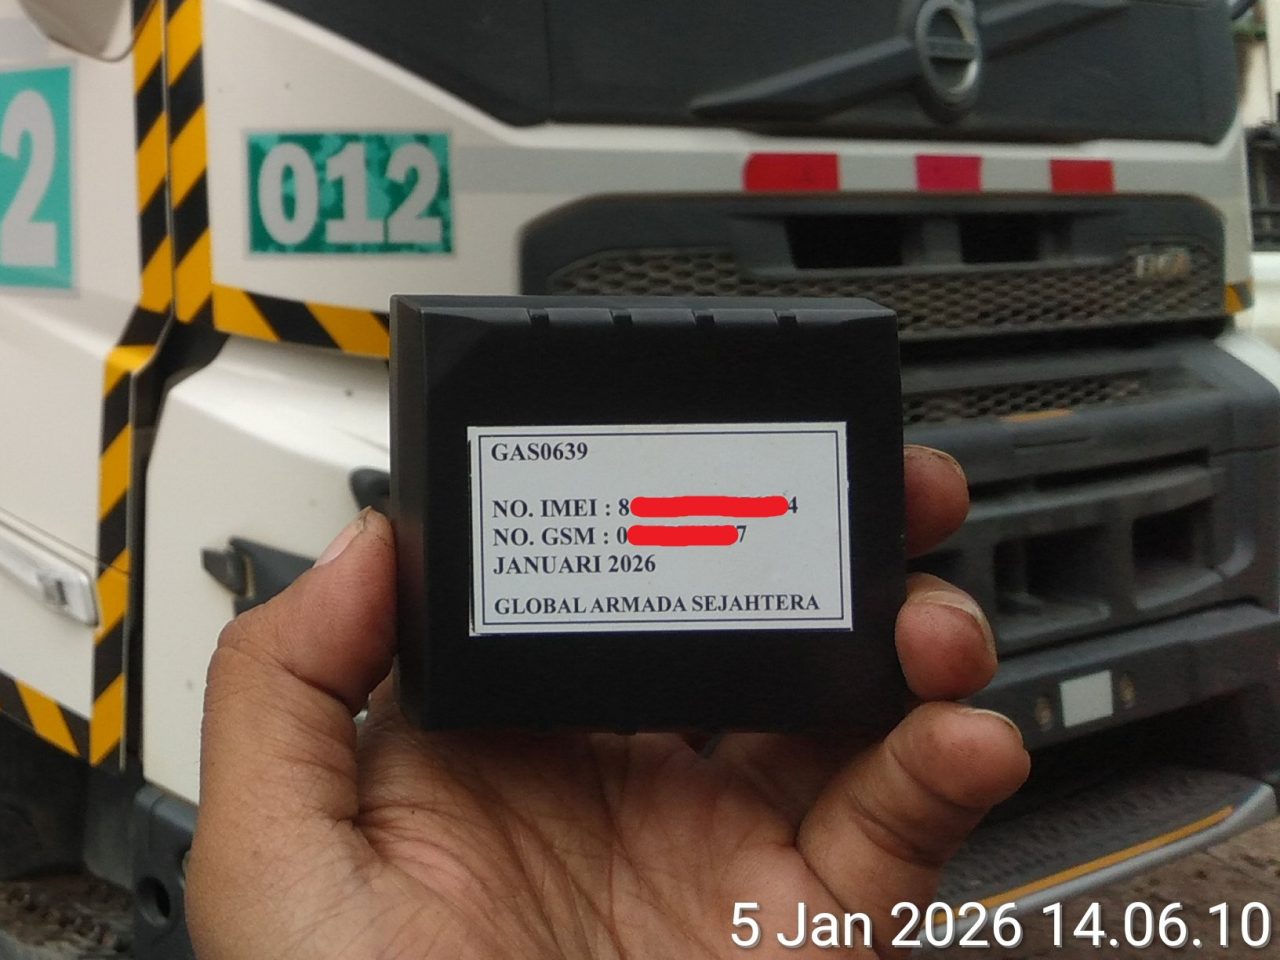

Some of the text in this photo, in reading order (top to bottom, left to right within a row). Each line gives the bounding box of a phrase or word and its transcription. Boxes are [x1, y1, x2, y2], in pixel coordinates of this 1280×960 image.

[257, 142, 442, 246] 012
[490, 441, 588, 462] GAS0639
[492, 499, 534, 518] NO.
[541, 498, 598, 517] IMEI
[492, 527, 534, 547] NO.
[541, 526, 596, 546] GSM
[493, 554, 656, 575] JANUARI 2026
[494, 594, 821, 615] GLOBAL ARMADA SEJAHTERA
